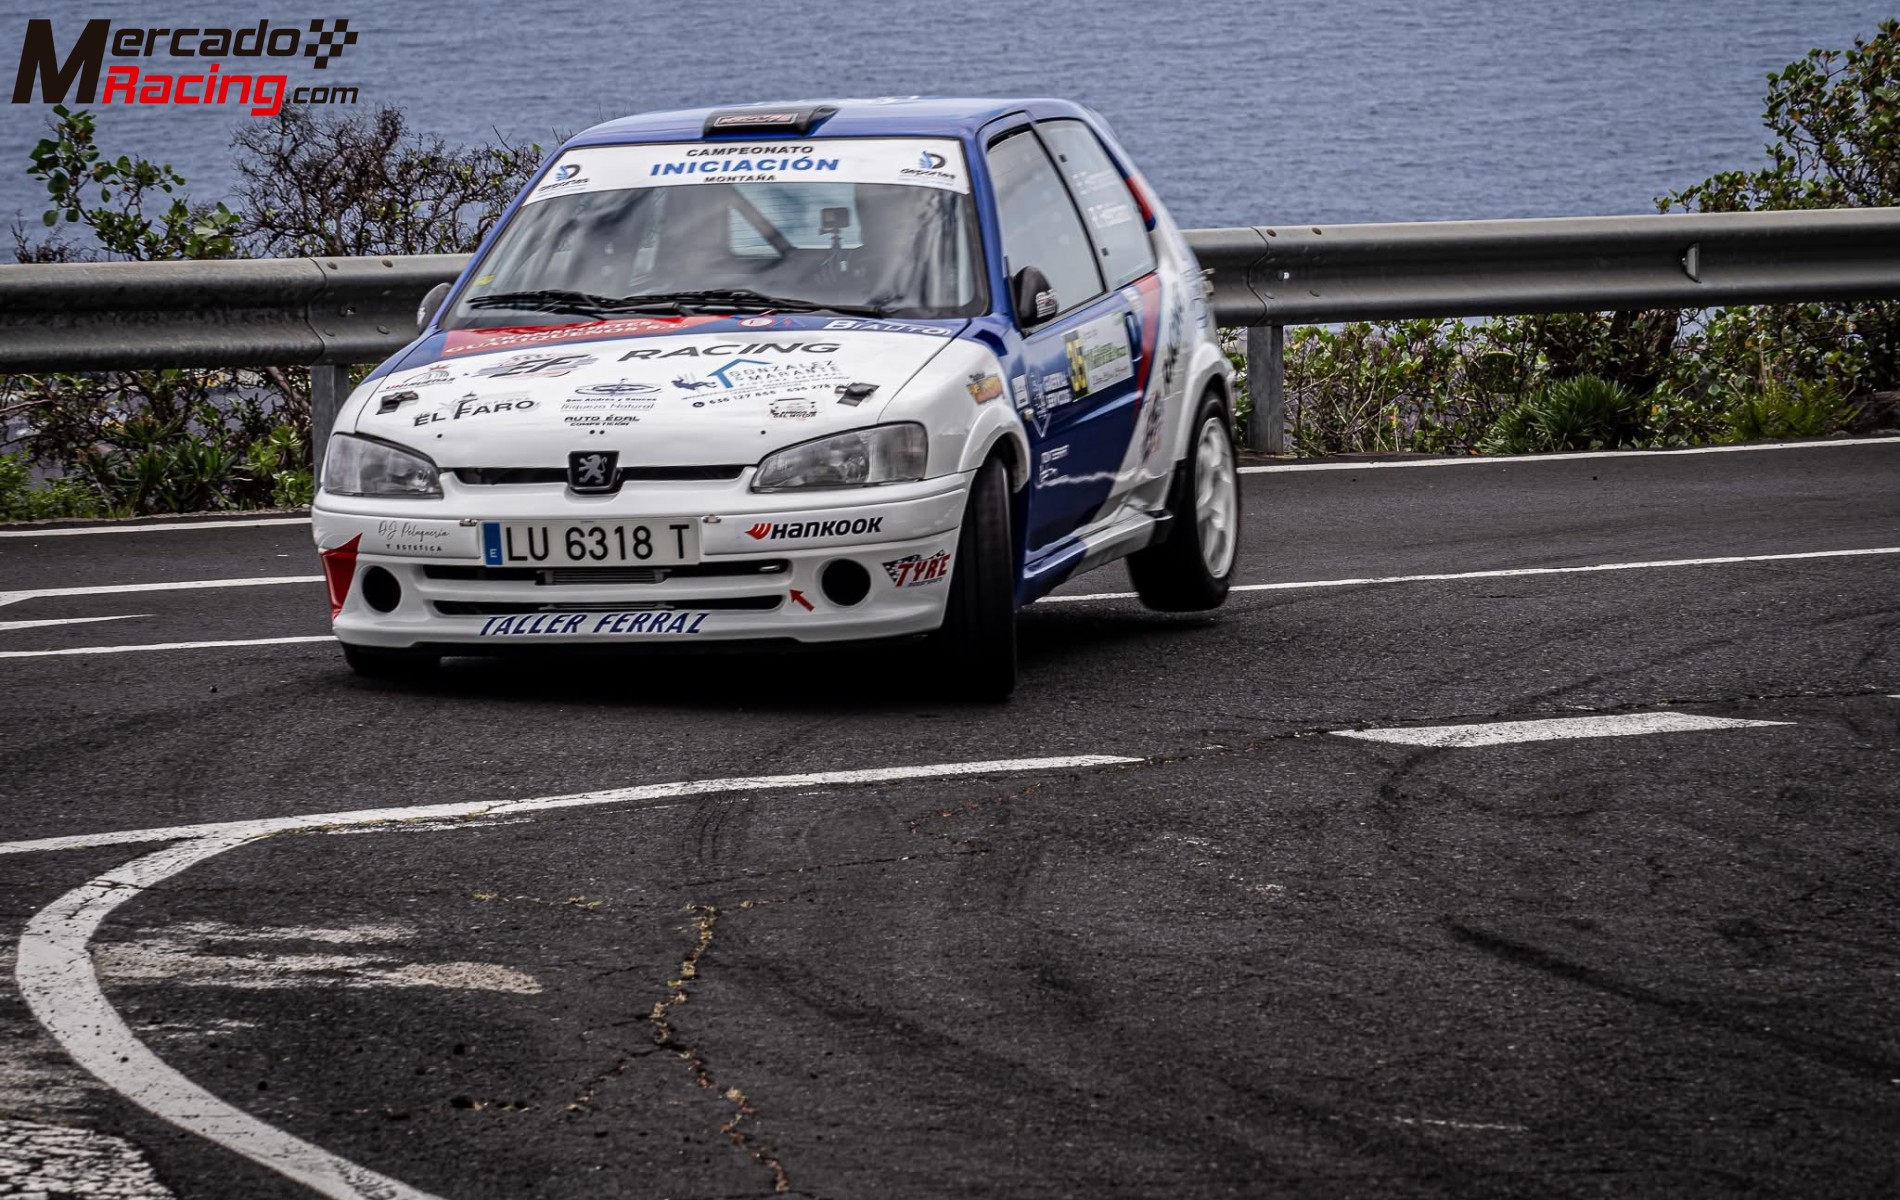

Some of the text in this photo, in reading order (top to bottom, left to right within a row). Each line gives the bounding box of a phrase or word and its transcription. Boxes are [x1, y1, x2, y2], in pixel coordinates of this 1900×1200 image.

[687, 146, 814, 157] CAMPEONATO
[650, 156, 840, 177] INICIACIÓN
[704, 173, 776, 183] MONTAÑA
[617, 342, 843, 362] RACING
[413, 412, 446, 427] EL
[453, 397, 535, 420] FARO
[489, 548, 498, 558] E
[506, 524, 691, 562] LU 6318 T
[895, 553, 951, 588] TYRE
[479, 611, 711, 637] TALLER FERRAZ
